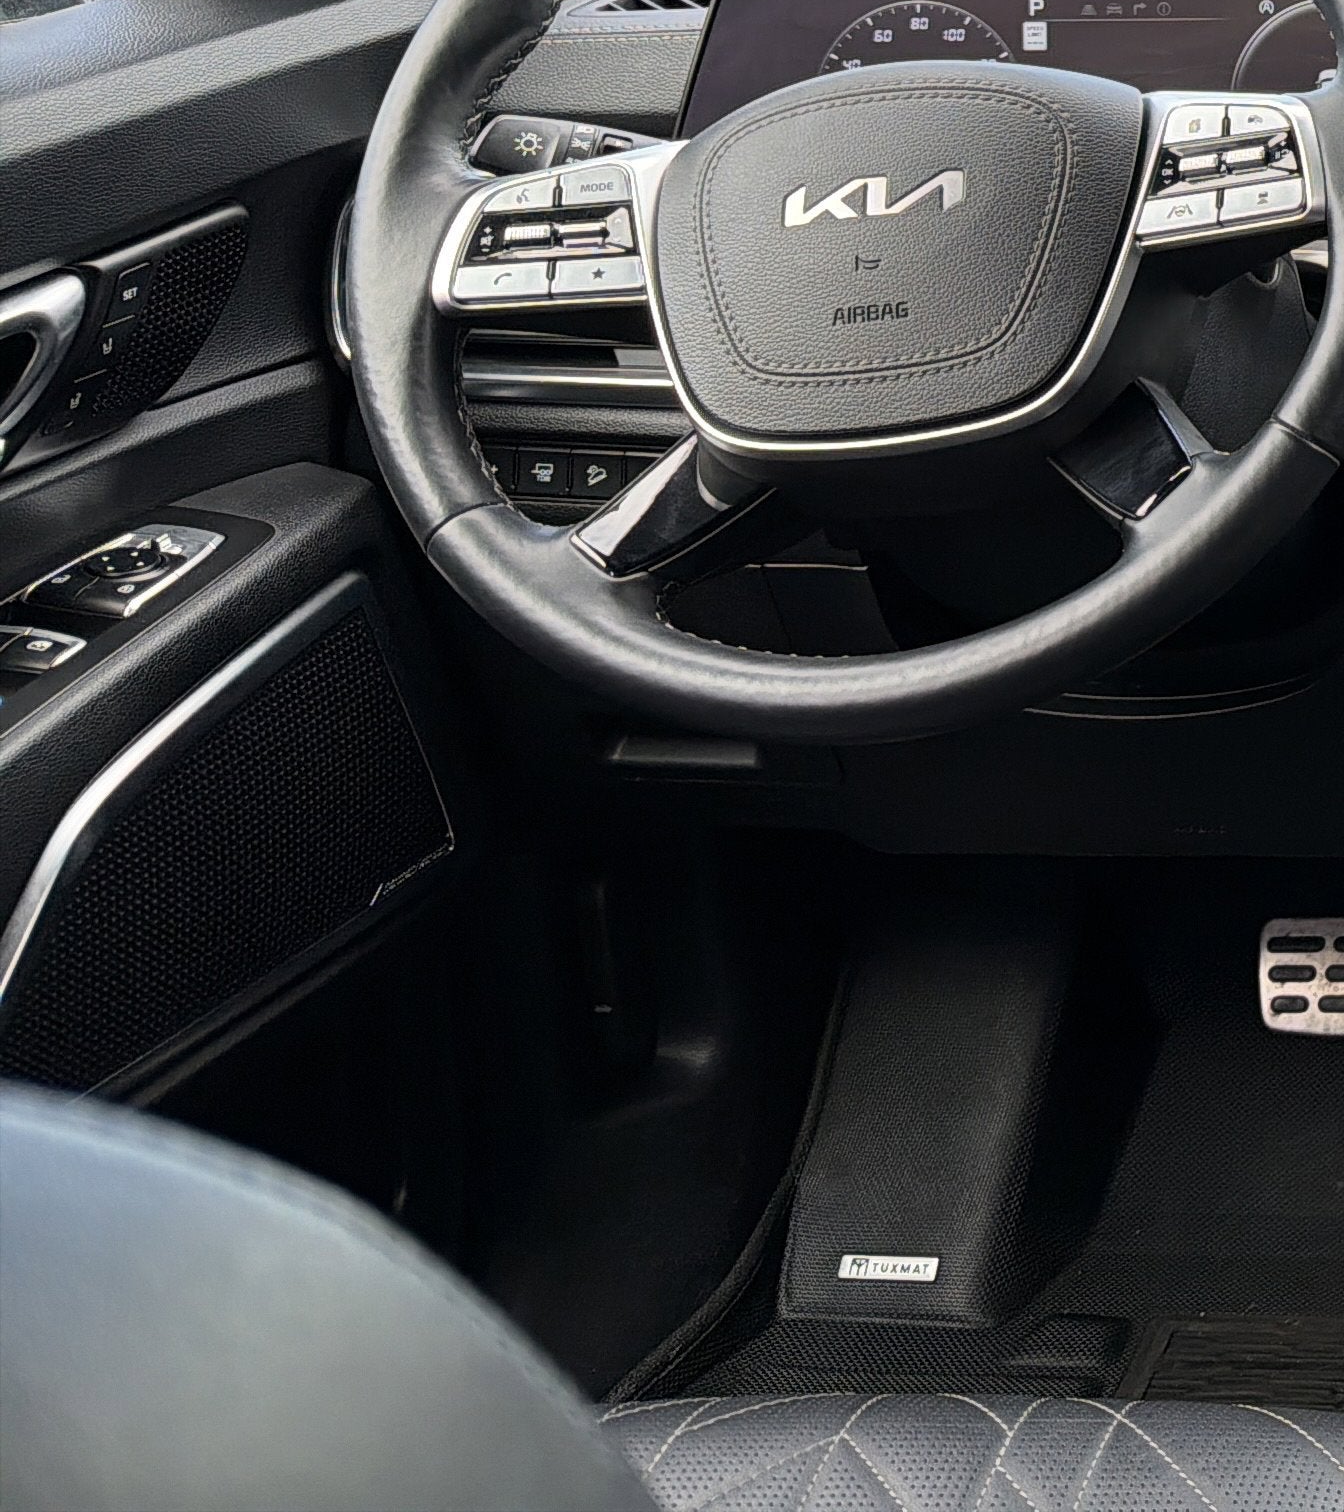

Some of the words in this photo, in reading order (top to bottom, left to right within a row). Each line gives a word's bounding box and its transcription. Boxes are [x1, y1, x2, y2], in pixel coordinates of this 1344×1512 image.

[909, 17, 930, 31] 80
[872, 29, 893, 43] 60
[942, 29, 966, 42] 100
[579, 181, 615, 194] MODE
[122, 286, 138, 302] SET
[831, 300, 910, 327] AIRBAG
[871, 1261, 930, 1275] TUXMAT
